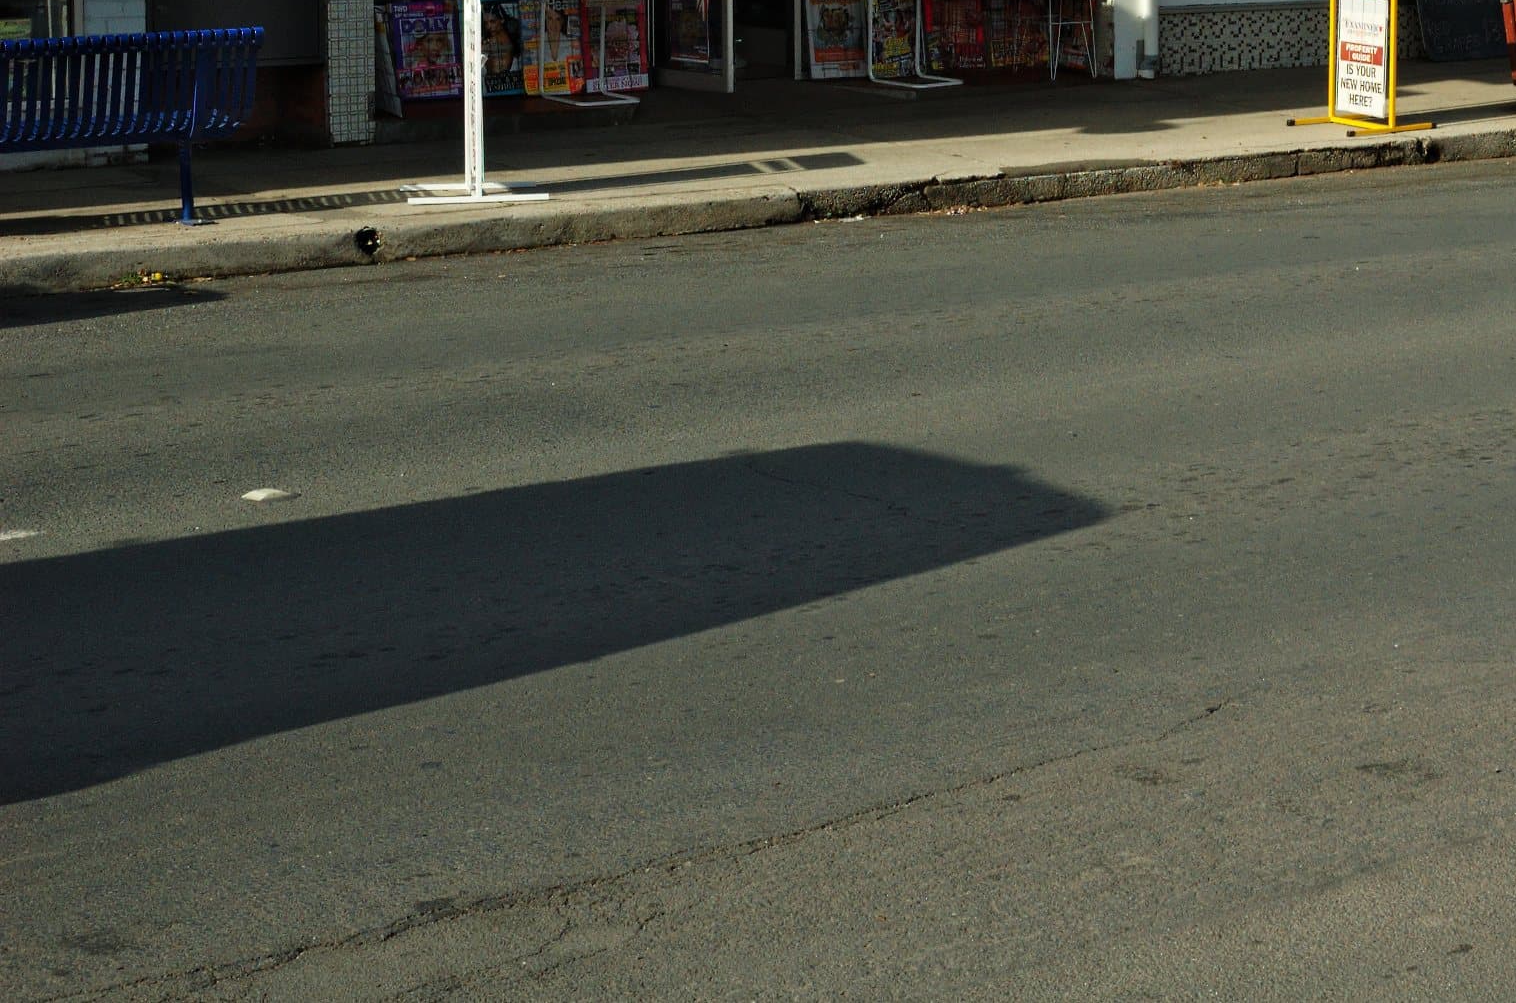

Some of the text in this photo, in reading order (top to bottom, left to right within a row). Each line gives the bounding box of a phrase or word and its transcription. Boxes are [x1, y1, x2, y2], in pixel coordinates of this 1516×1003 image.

[1346, 63, 1376, 78] IS YOUR
[1341, 77, 1382, 94] NEW HOME
[1349, 93, 1373, 107] HERE?
